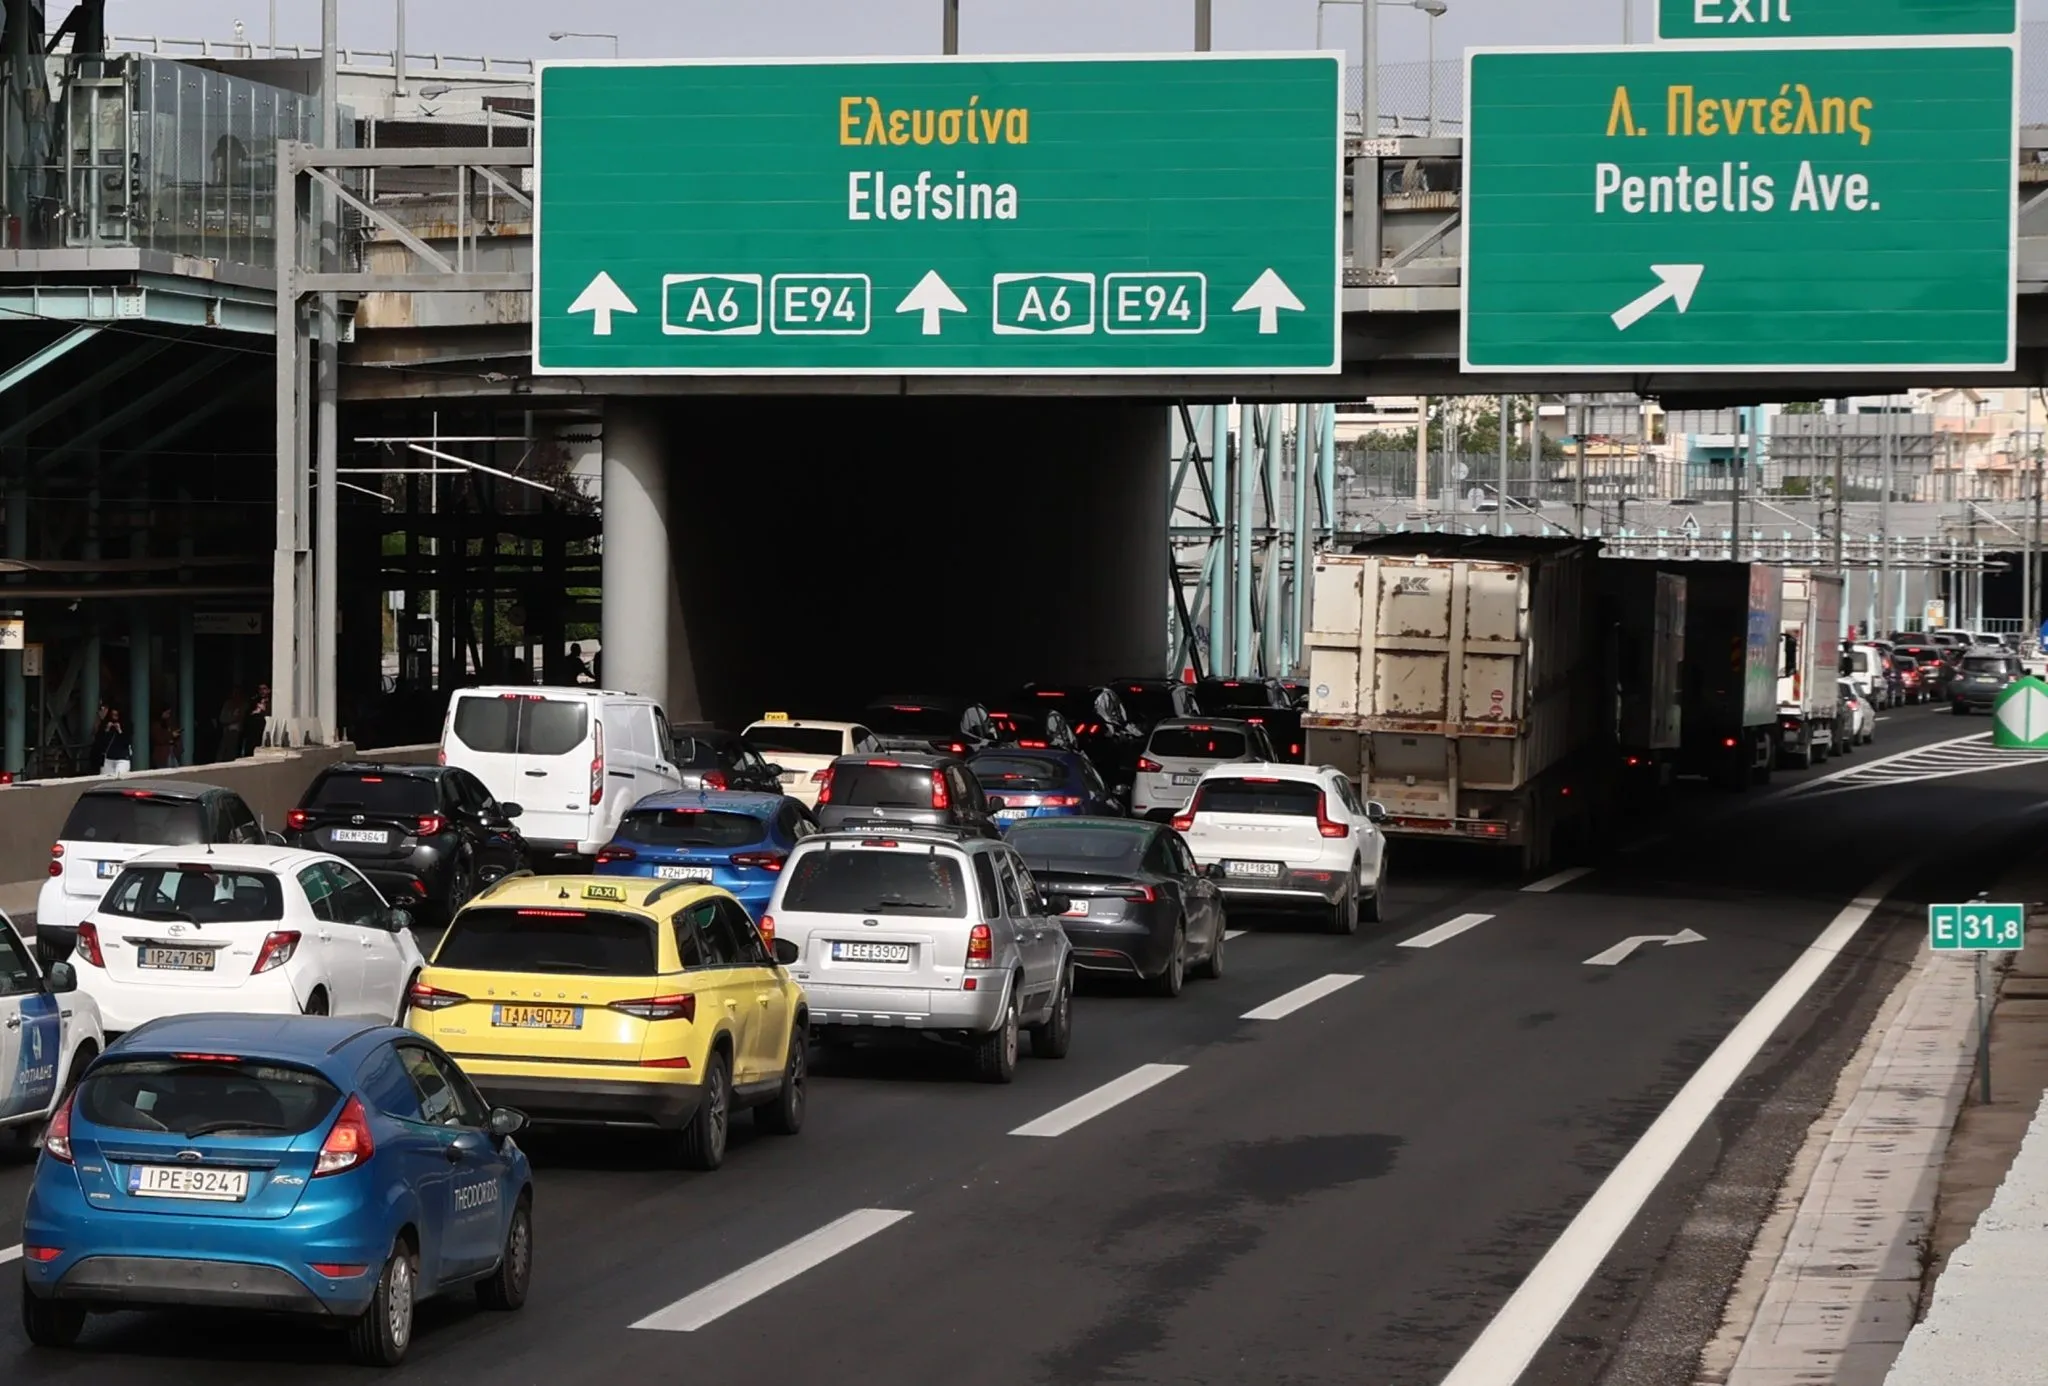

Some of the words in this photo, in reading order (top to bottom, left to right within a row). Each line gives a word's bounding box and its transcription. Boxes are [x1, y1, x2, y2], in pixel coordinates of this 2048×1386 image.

[839, 95, 1028, 146] Ελευσίνα
[1606, 86, 1647, 137] Λ.
[1667, 84, 1873, 146] Πεντέλης
[848, 170, 1018, 221] Elefsina
[1595, 161, 1775, 213] Pentelis
[1790, 160, 1880, 212] Ave.
[686, 286, 739, 323] A6
[784, 286, 856, 322] E94
[1017, 286, 1071, 322] A6
[1118, 285, 1191, 322] E94
[590, 886, 616, 897] TAXI
[1936, 915, 1955, 941] E
[1967, 914, 2018, 944] 31,8
